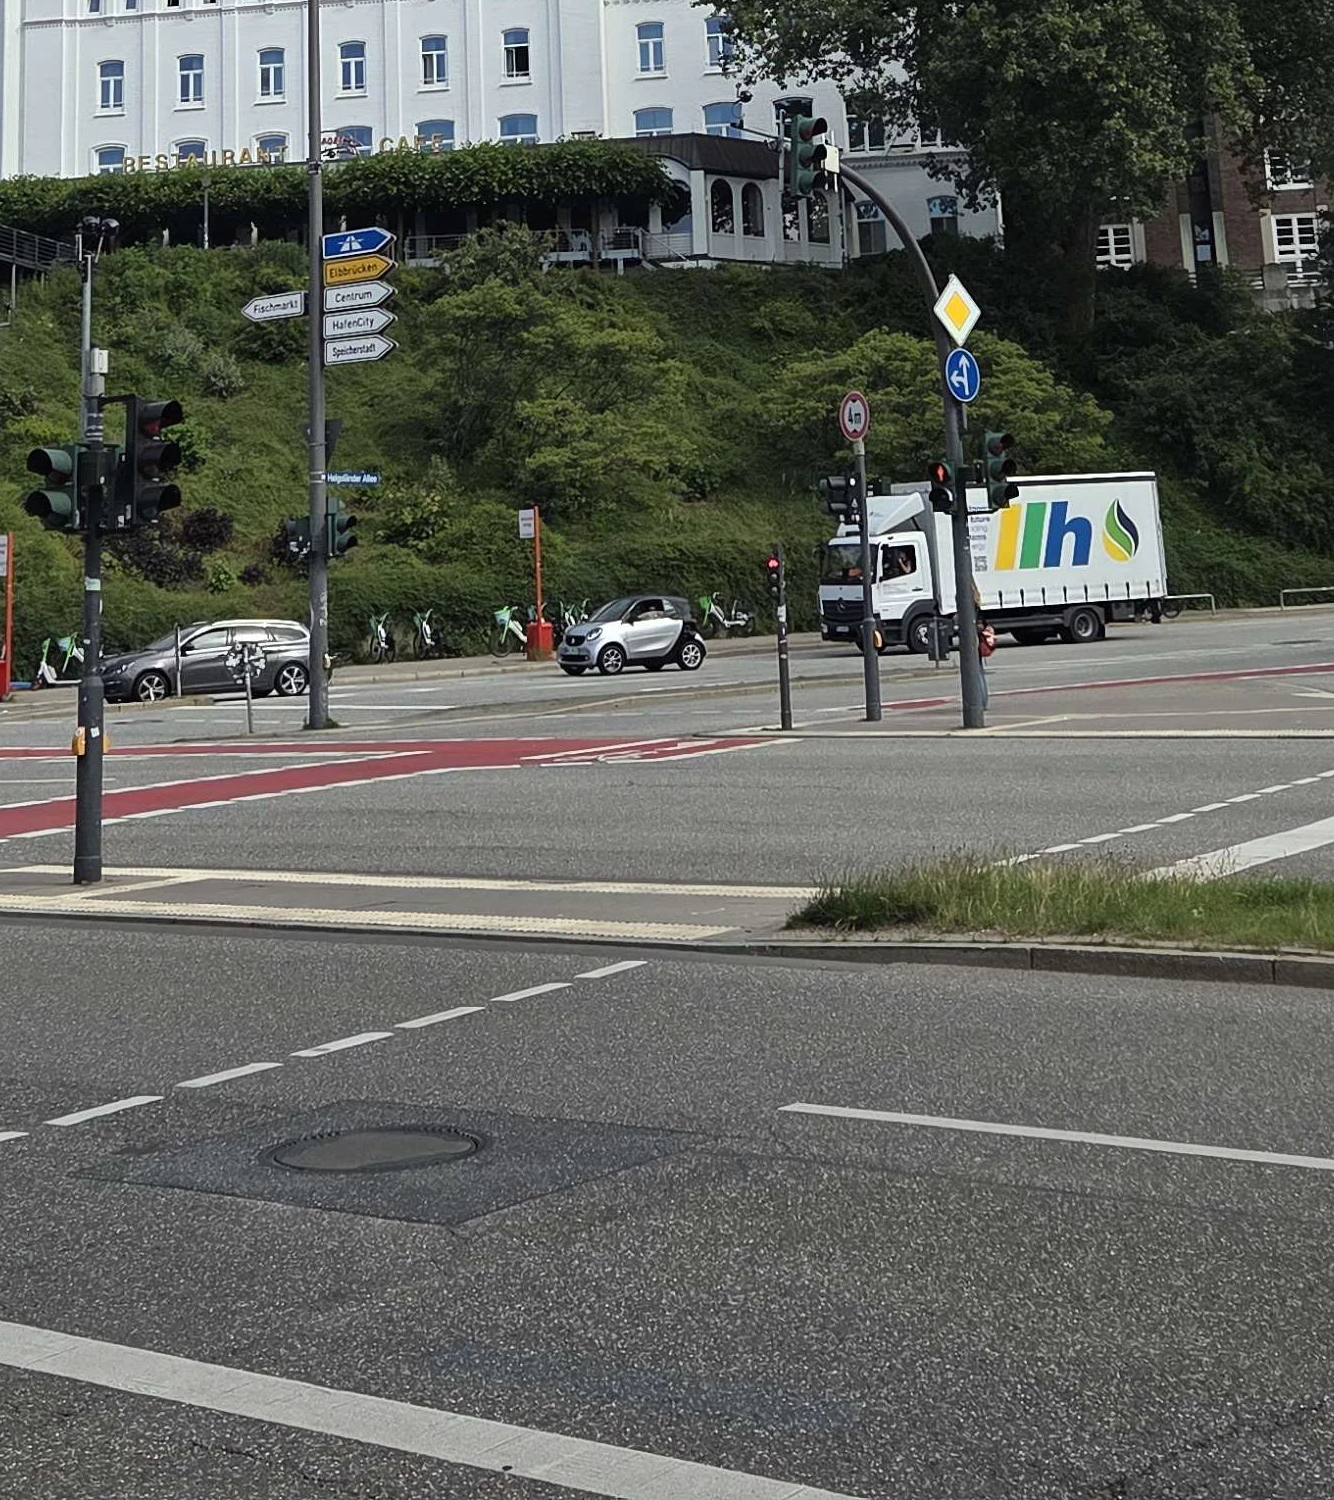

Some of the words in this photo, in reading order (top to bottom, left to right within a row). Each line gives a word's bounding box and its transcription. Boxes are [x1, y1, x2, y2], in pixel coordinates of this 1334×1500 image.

[123, 145, 289, 173] RESTAURANT
[329, 262, 379, 278] Elbbrücken
[335, 290, 373, 303] Centrum
[253, 300, 299, 314] Fischmarkt
[332, 318, 375, 331] HafenCity
[332, 343, 376, 358] Speicherstadt
[362, 472, 378, 483] Allee
